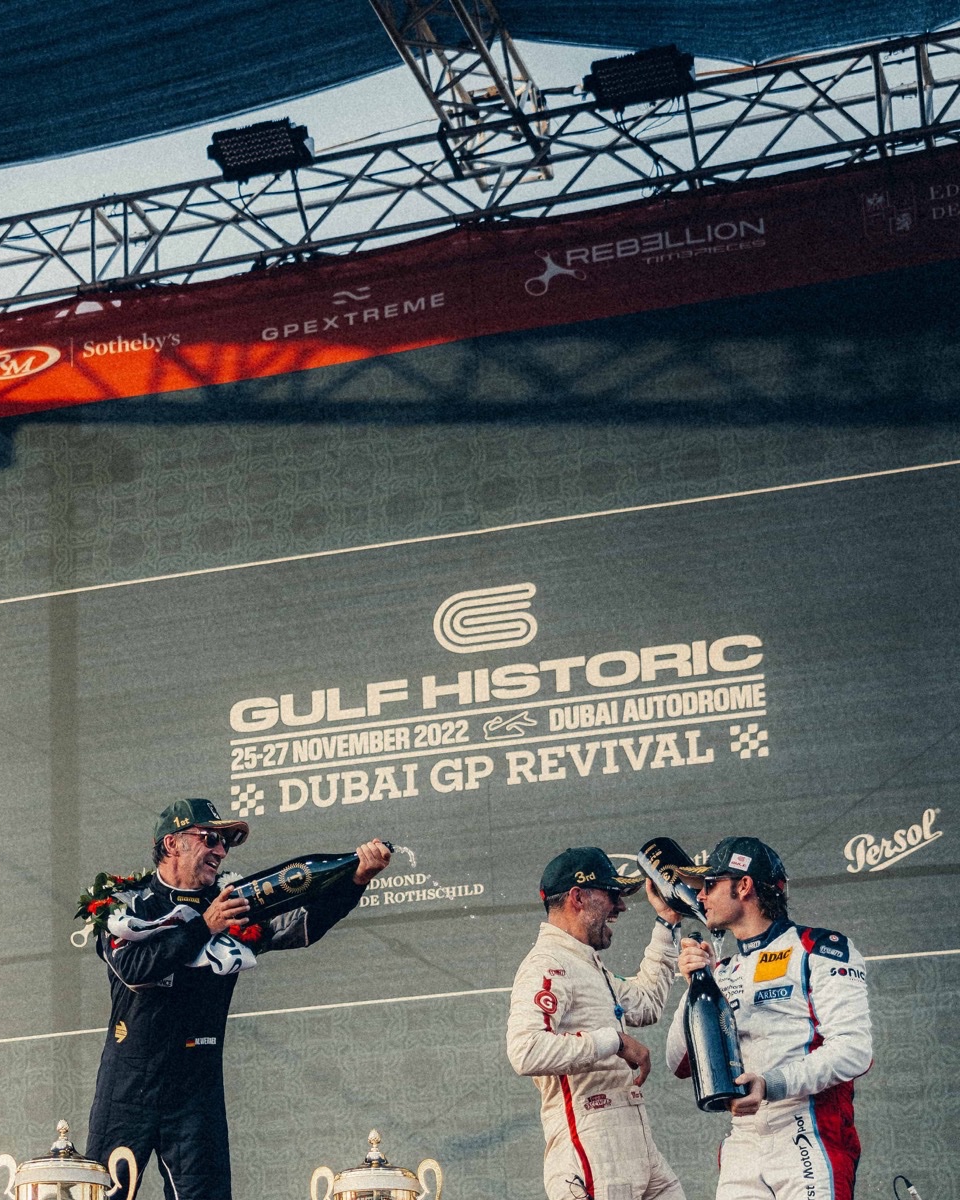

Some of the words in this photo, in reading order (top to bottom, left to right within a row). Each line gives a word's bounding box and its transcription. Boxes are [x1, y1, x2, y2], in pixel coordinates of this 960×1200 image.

[261, 293, 445, 341] GPEXTREME
[82, 332, 181, 359] Sotheby's
[229, 678, 409, 733] GULF
[421, 634, 764, 709] HISTORIC
[549, 700, 618, 732] DUBAI
[622, 682, 766, 723] AUTODROME
[230, 742, 289, 771] 25-27
[292, 727, 410, 764] NOVEMBER
[414, 719, 469, 749] 2022
[278, 763, 419, 814] DUBAI
[429, 754, 495, 794] GP
[505, 729, 715, 786] REVIVAL
[173, 816, 190, 828] 1st
[843, 808, 943, 874] Persol
[360, 895, 380, 907] DE
[383, 884, 485, 905] ROTHSCHILD
[366, 873, 427, 890] DMOND
[574, 871, 596, 884] 3rd
[759, 949, 791, 964] ADAC
